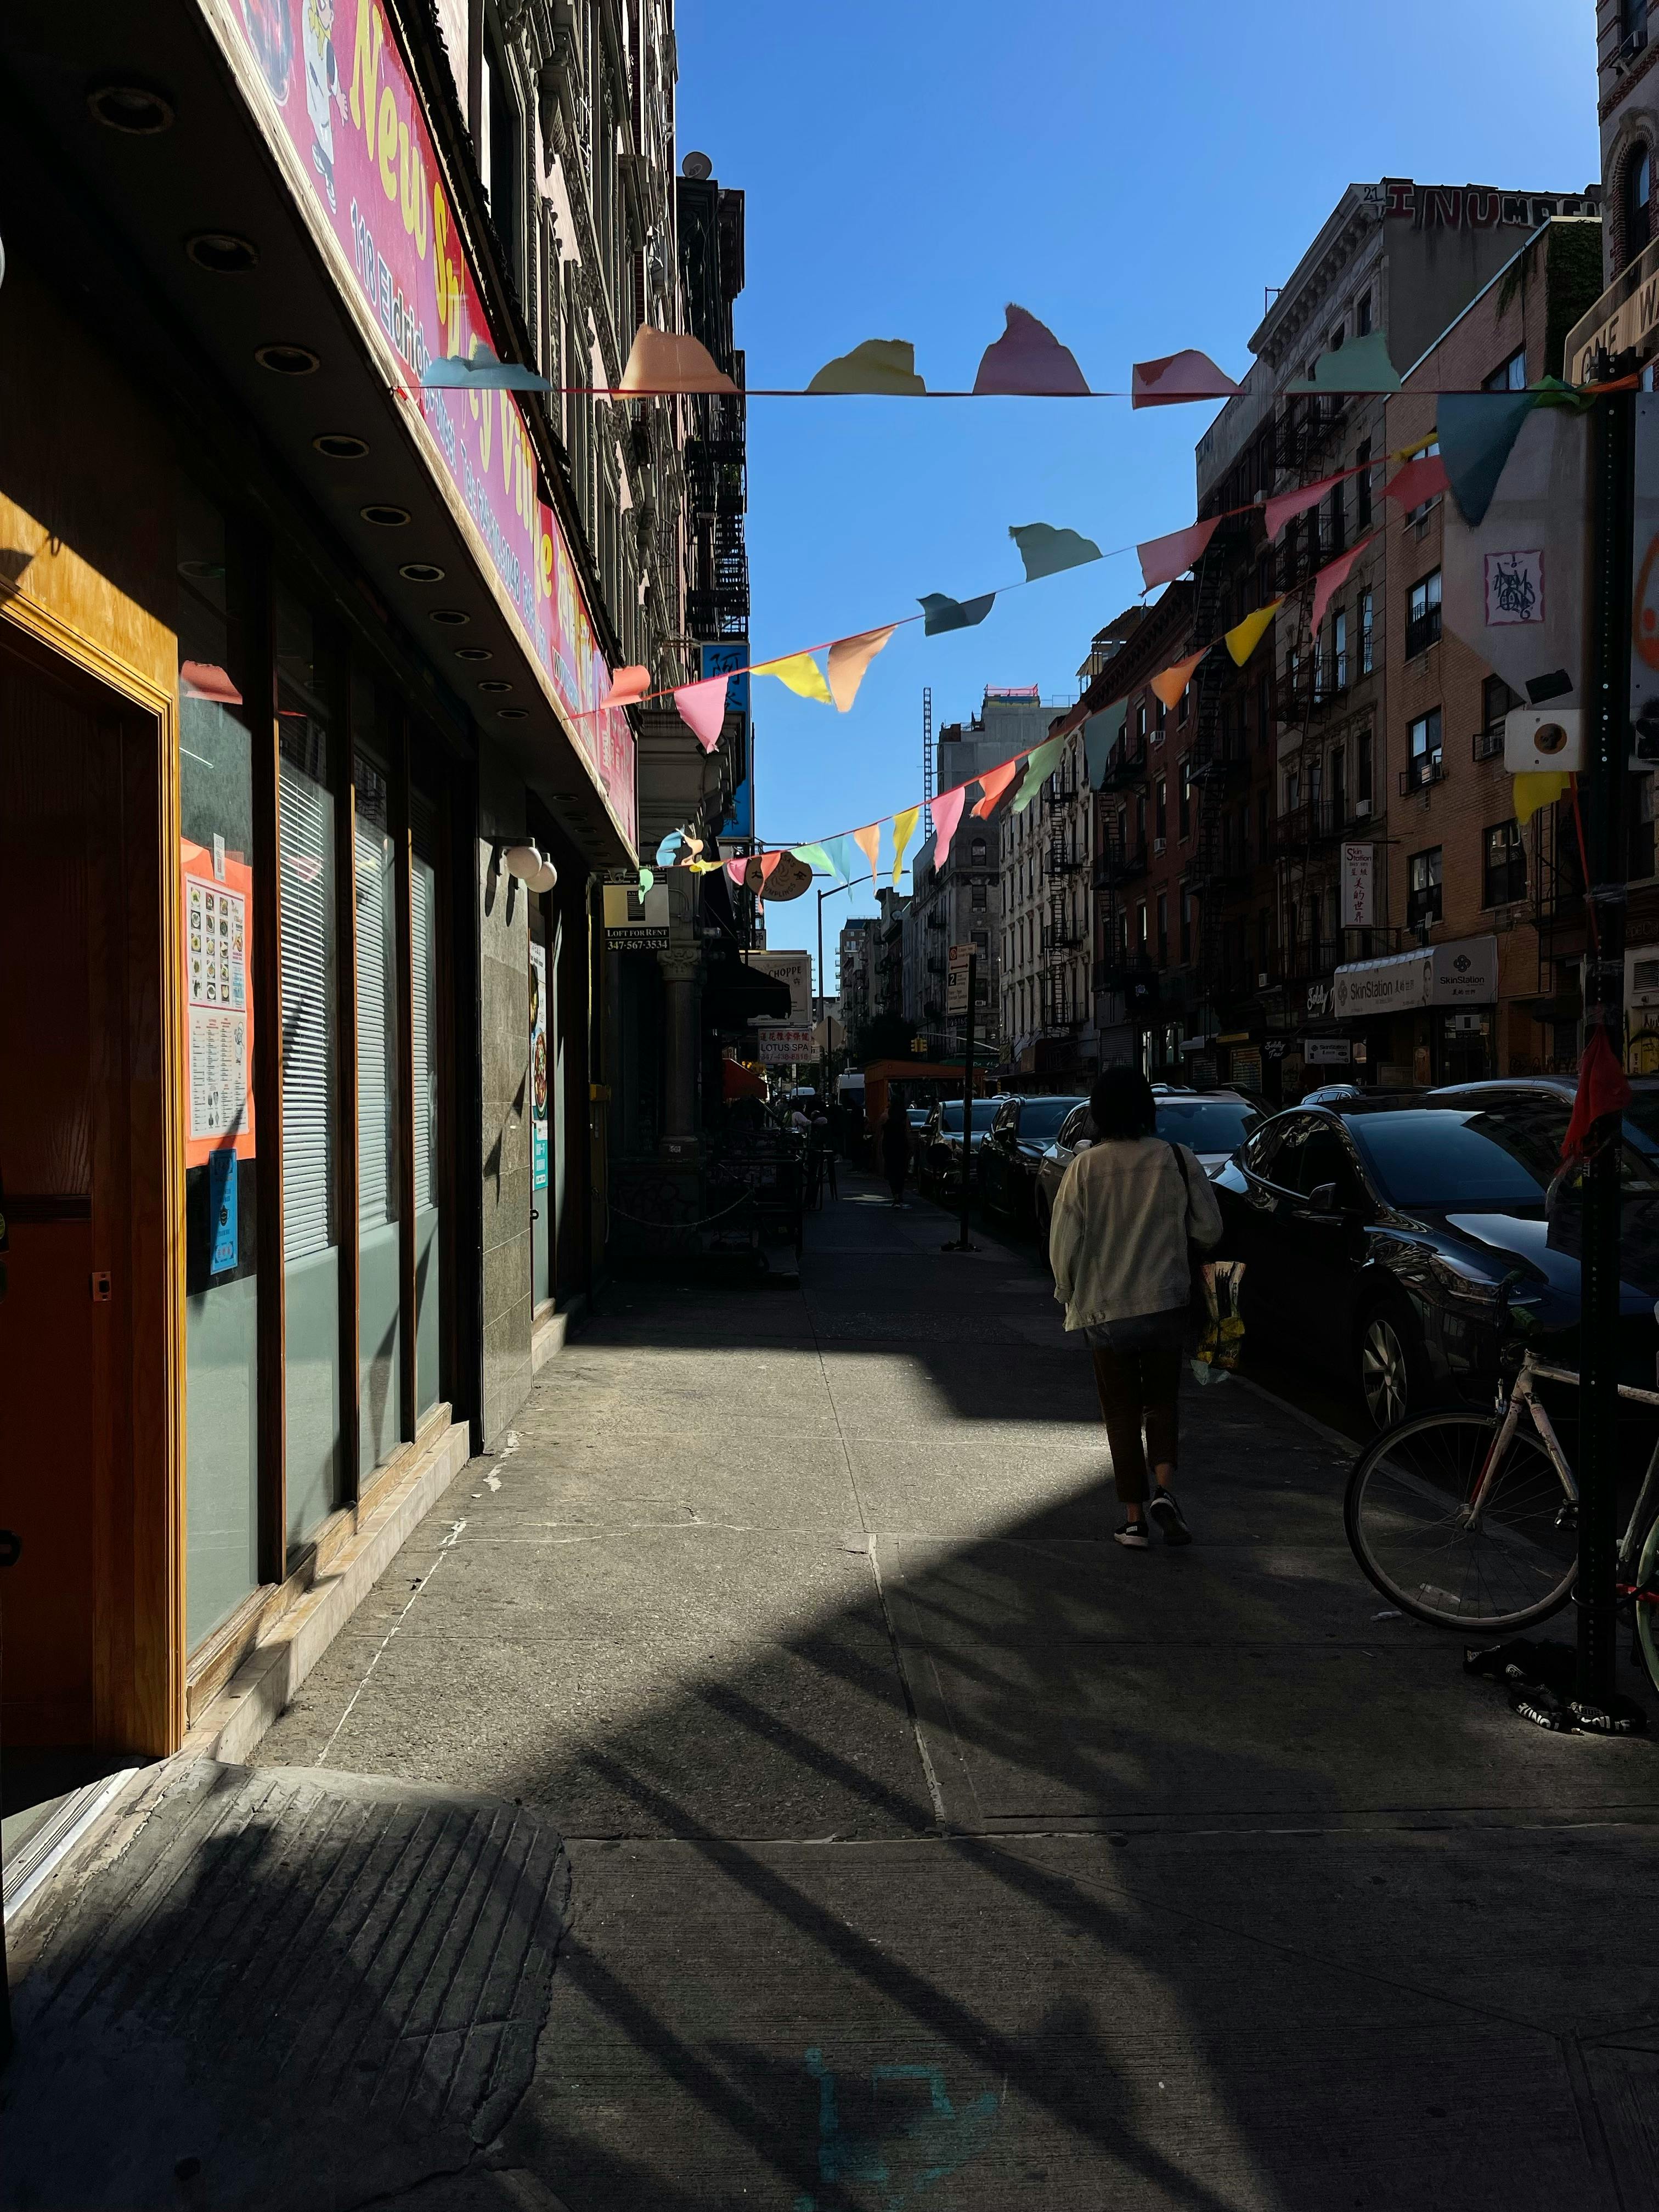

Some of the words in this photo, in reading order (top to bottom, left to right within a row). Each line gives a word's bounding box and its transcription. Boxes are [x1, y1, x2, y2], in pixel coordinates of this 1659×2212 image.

[351, 0, 427, 260] New
[350, 196, 377, 307] 118
[763, 882, 796, 898] UMPLINGS
[607, 929, 629, 937] LOFT
[645, 928, 668, 936] RENT
[1440, 975, 1485, 985] SkinStation
[1350, 980, 1393, 1001] SkinStation
[761, 1043, 790, 1052] LOTUS
[792, 1043, 809, 1052] SPA
